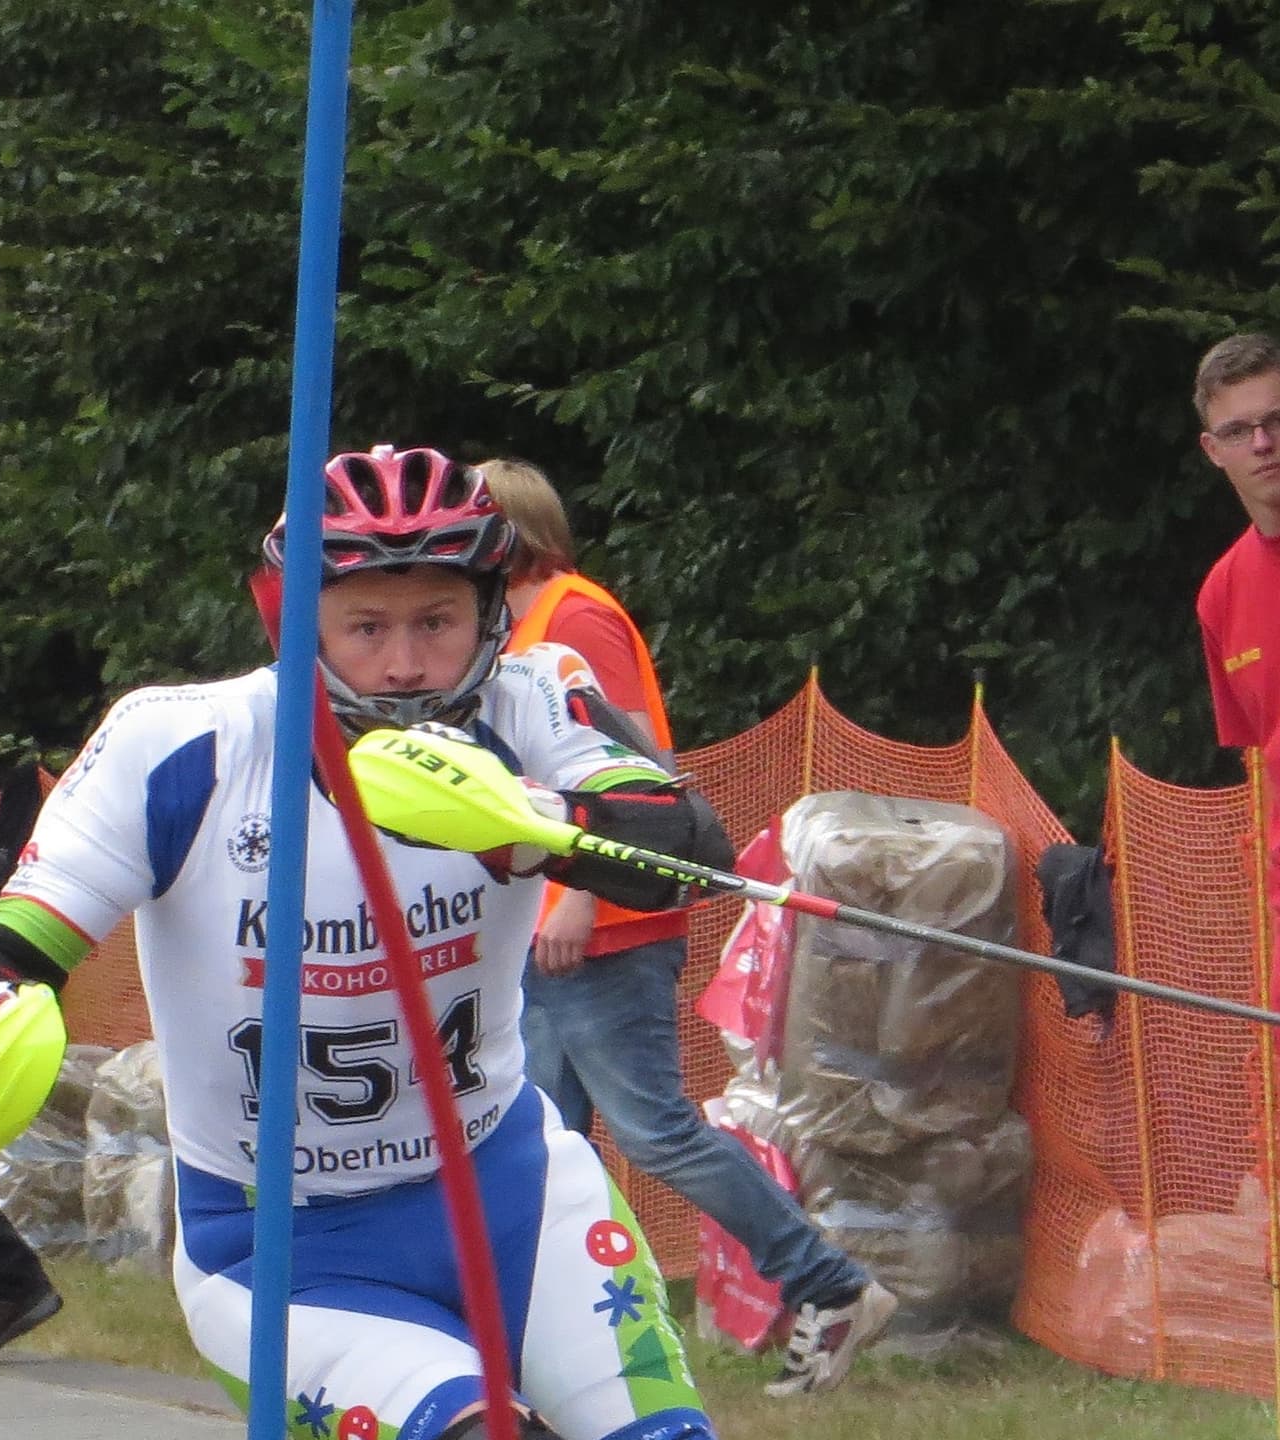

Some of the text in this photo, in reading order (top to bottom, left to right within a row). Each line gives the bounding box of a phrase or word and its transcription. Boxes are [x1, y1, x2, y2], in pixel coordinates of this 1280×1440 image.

[382, 738, 470, 786] LEKI
[235, 883, 486, 955] Kombcher
[228, 988, 487, 1127] 154
